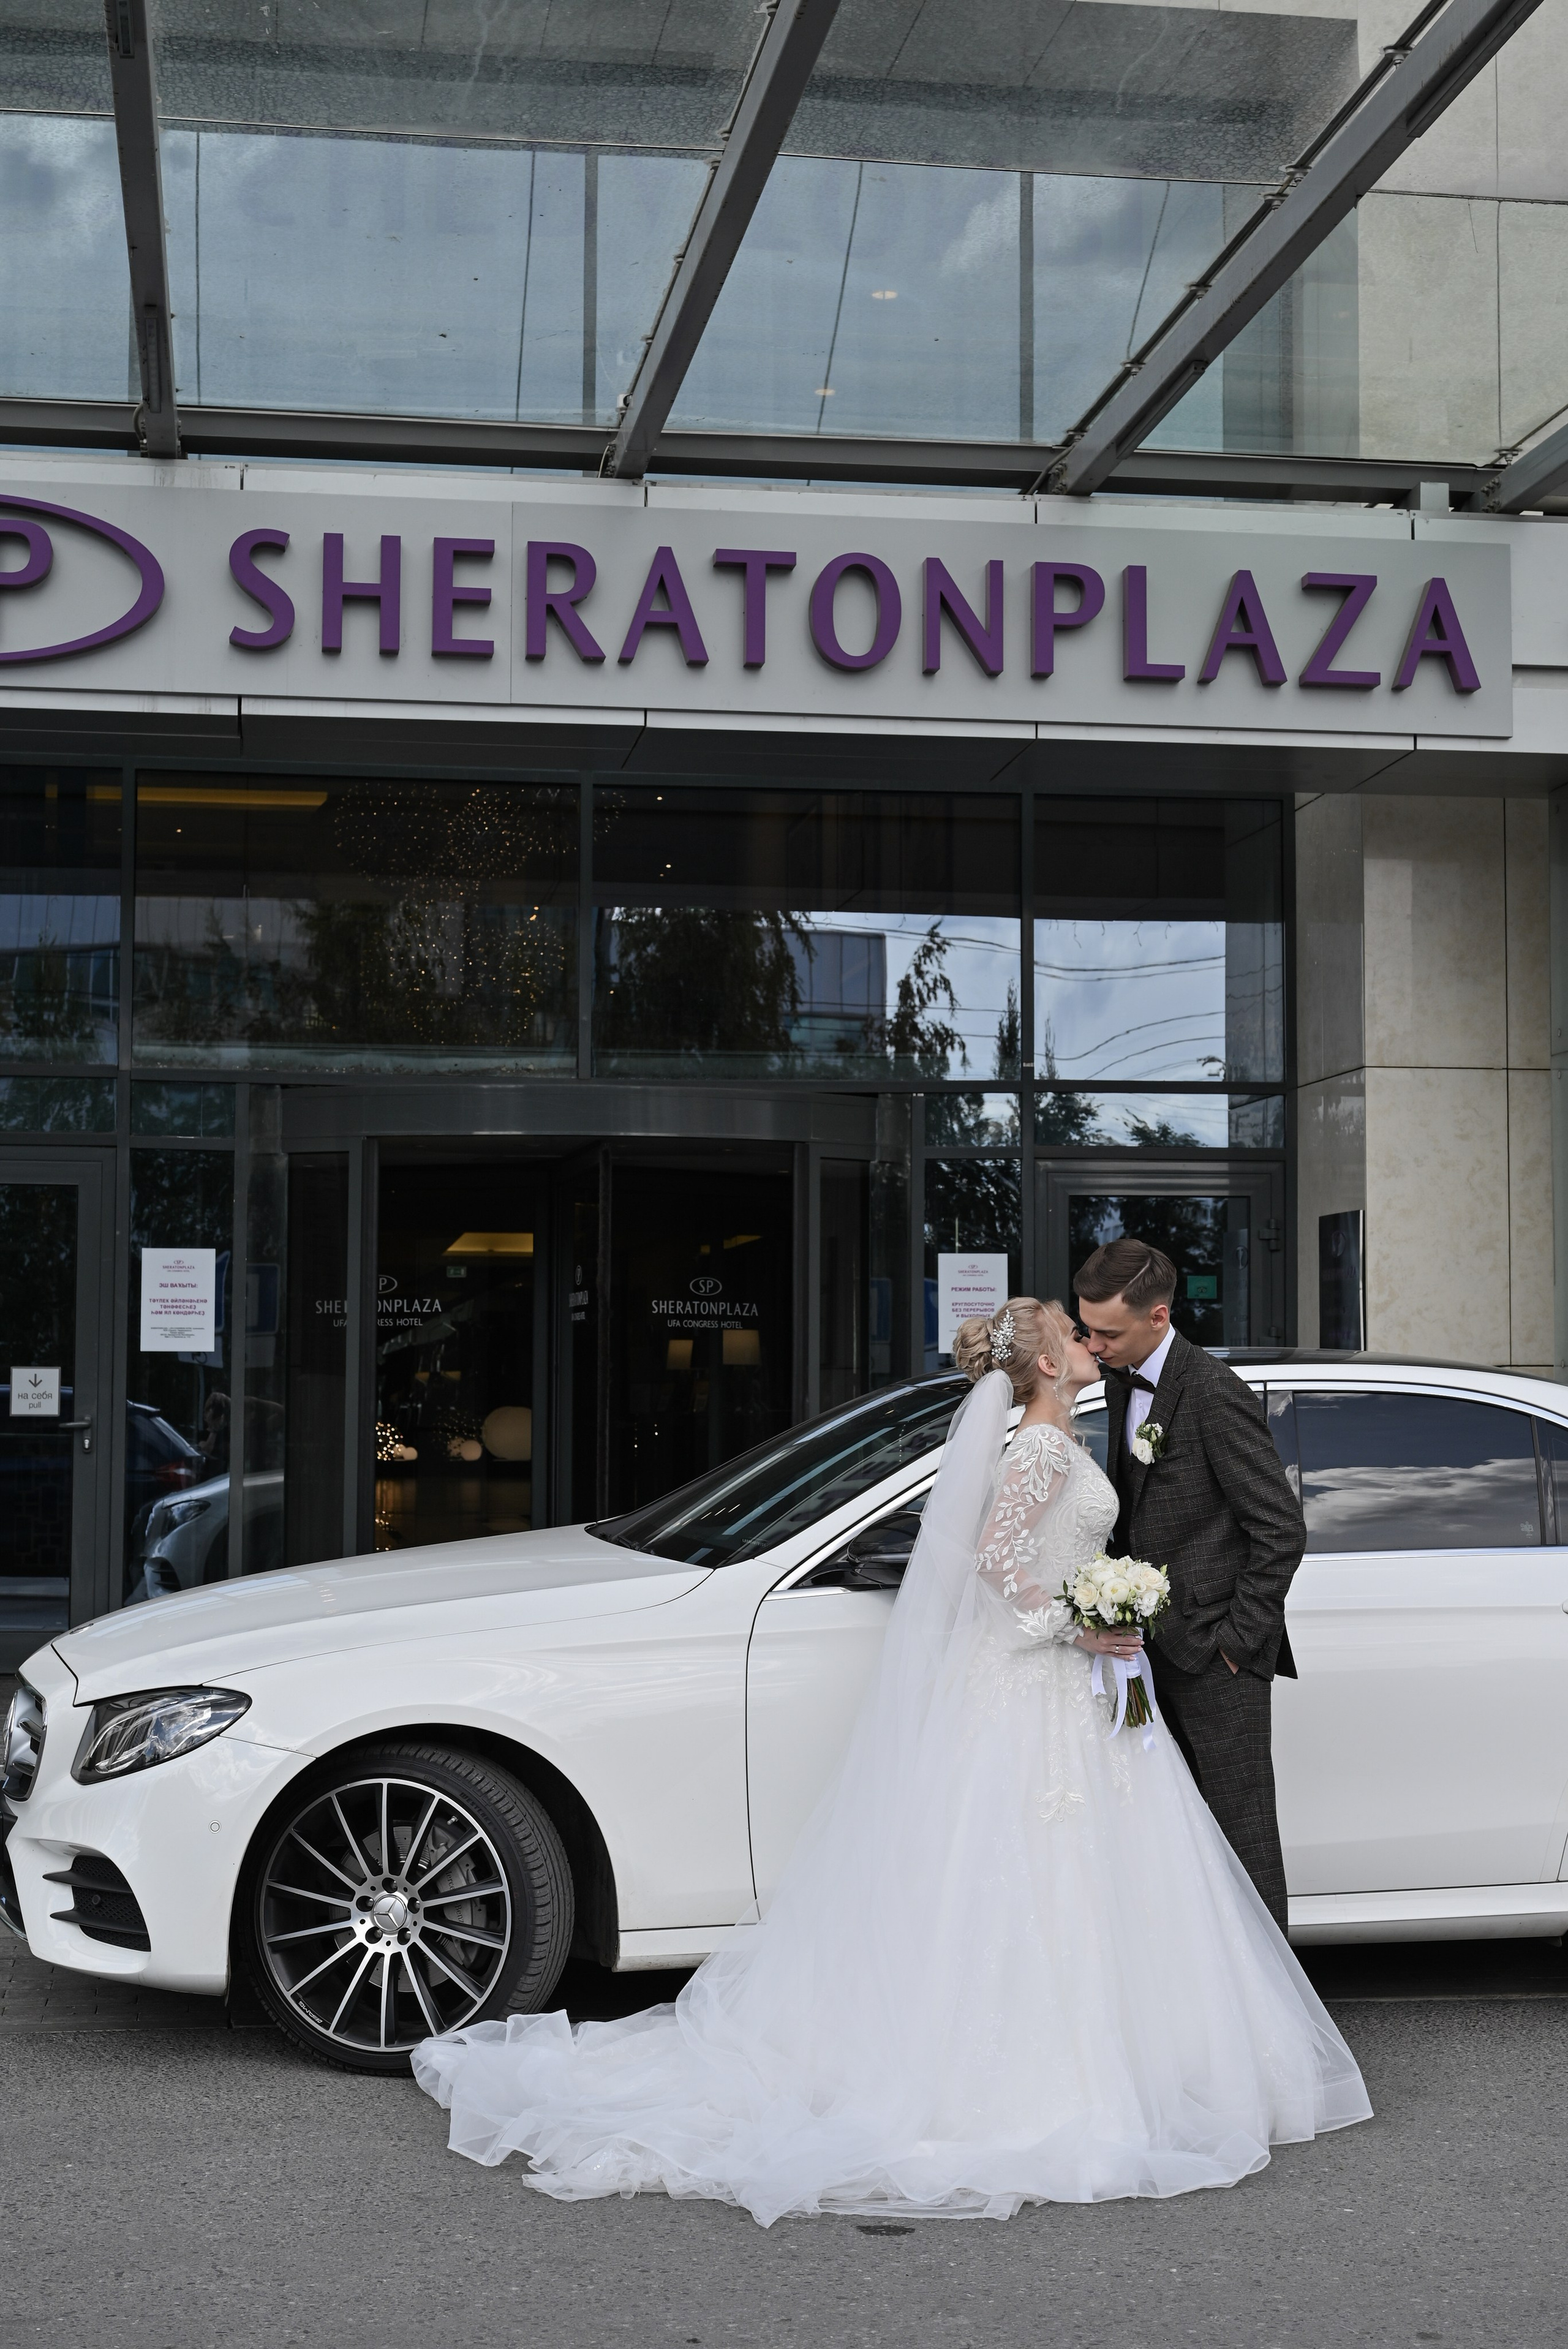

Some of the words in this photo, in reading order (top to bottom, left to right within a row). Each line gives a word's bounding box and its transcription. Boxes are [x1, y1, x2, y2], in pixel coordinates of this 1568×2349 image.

[229, 528, 1482, 693] SHERATONPLAZA
[699, 1280, 714, 1293] SP
[652, 1300, 758, 1316] SHERATONPLAZA
[31, 1391, 53, 1400] себя
[29, 1401, 42, 1410] pull
